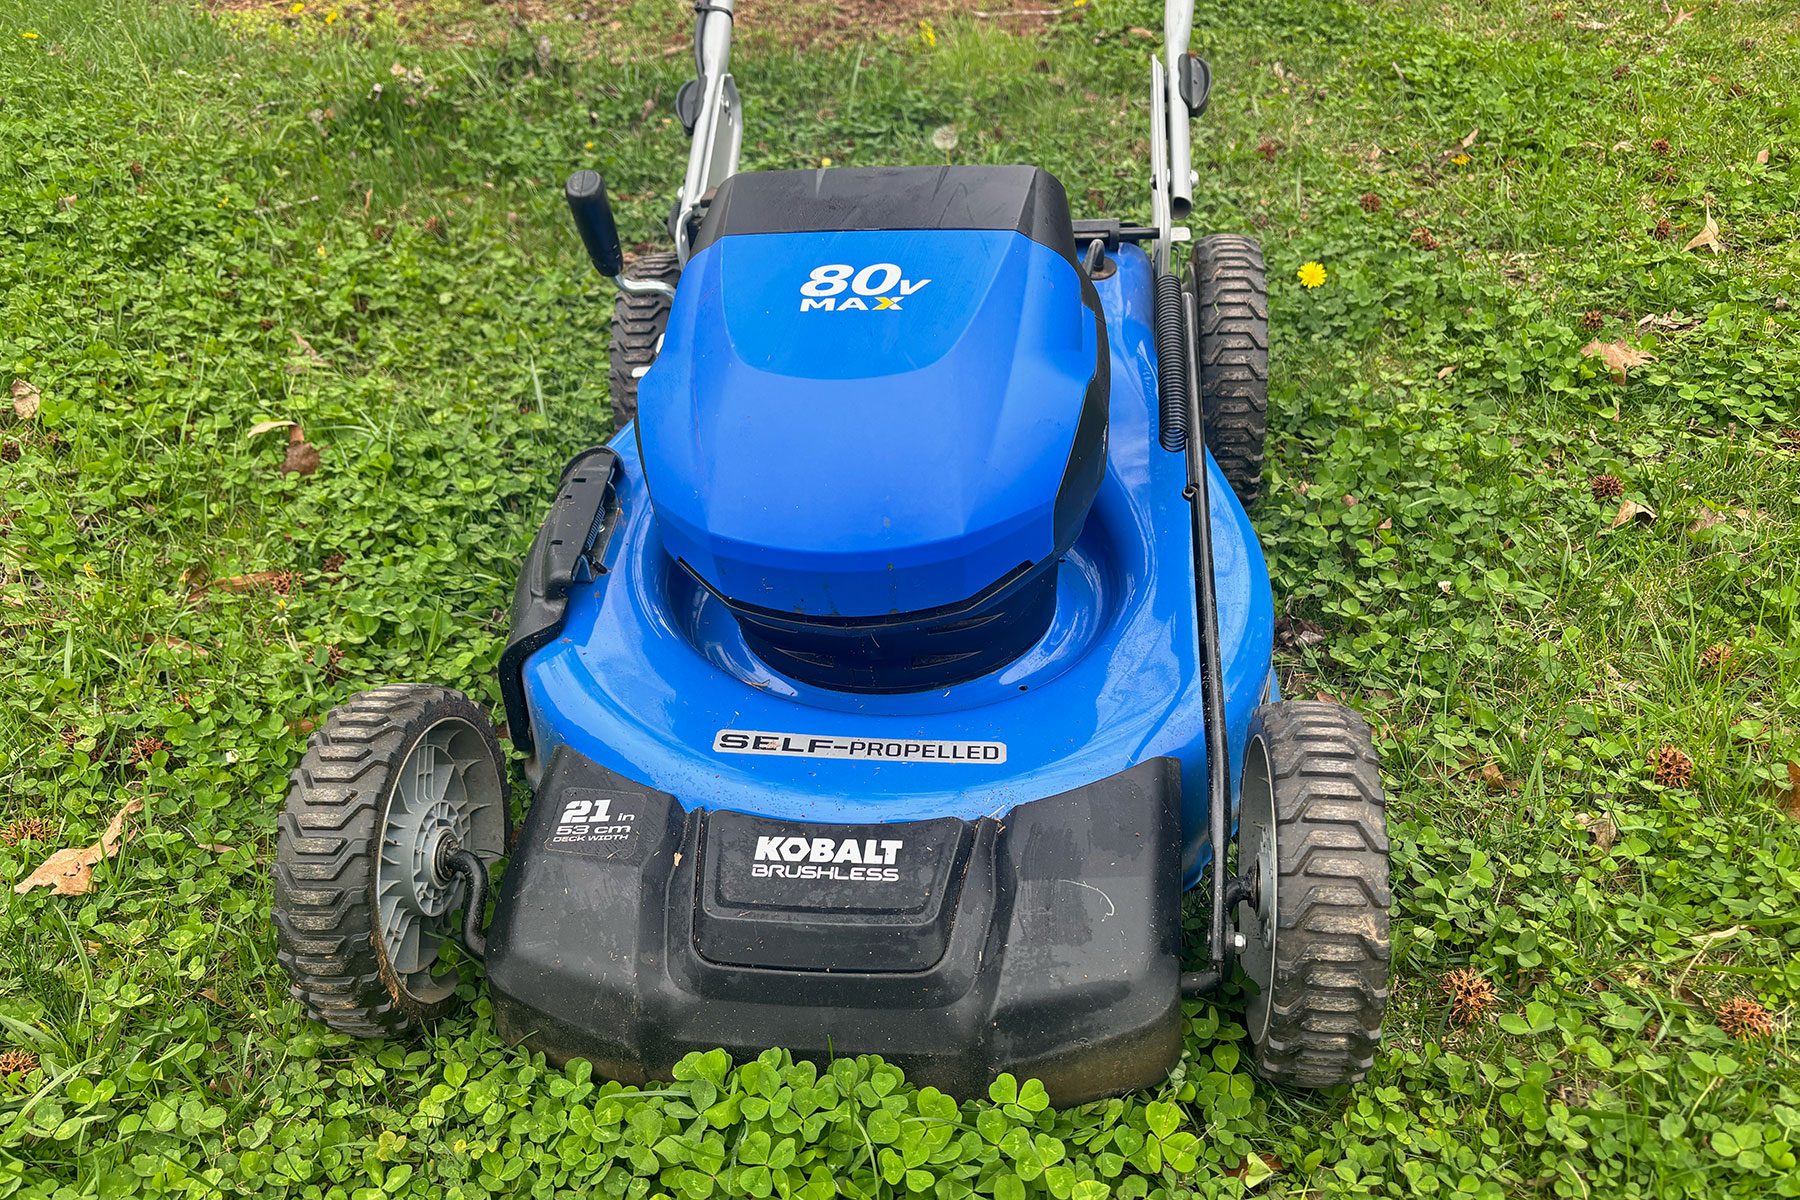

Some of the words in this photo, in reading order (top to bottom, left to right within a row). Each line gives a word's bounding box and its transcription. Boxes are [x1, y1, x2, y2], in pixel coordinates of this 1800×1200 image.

[799, 297, 905, 312] MAX
[718, 734, 1000, 760] SELF-PROPELLED
[560, 799, 611, 823] 21
[617, 813, 635, 821] in
[556, 825, 590, 835] 53
[594, 825, 631, 834] cm
[754, 836, 903, 865] KOBALT
[751, 864, 899, 882] BRUSHLESS
